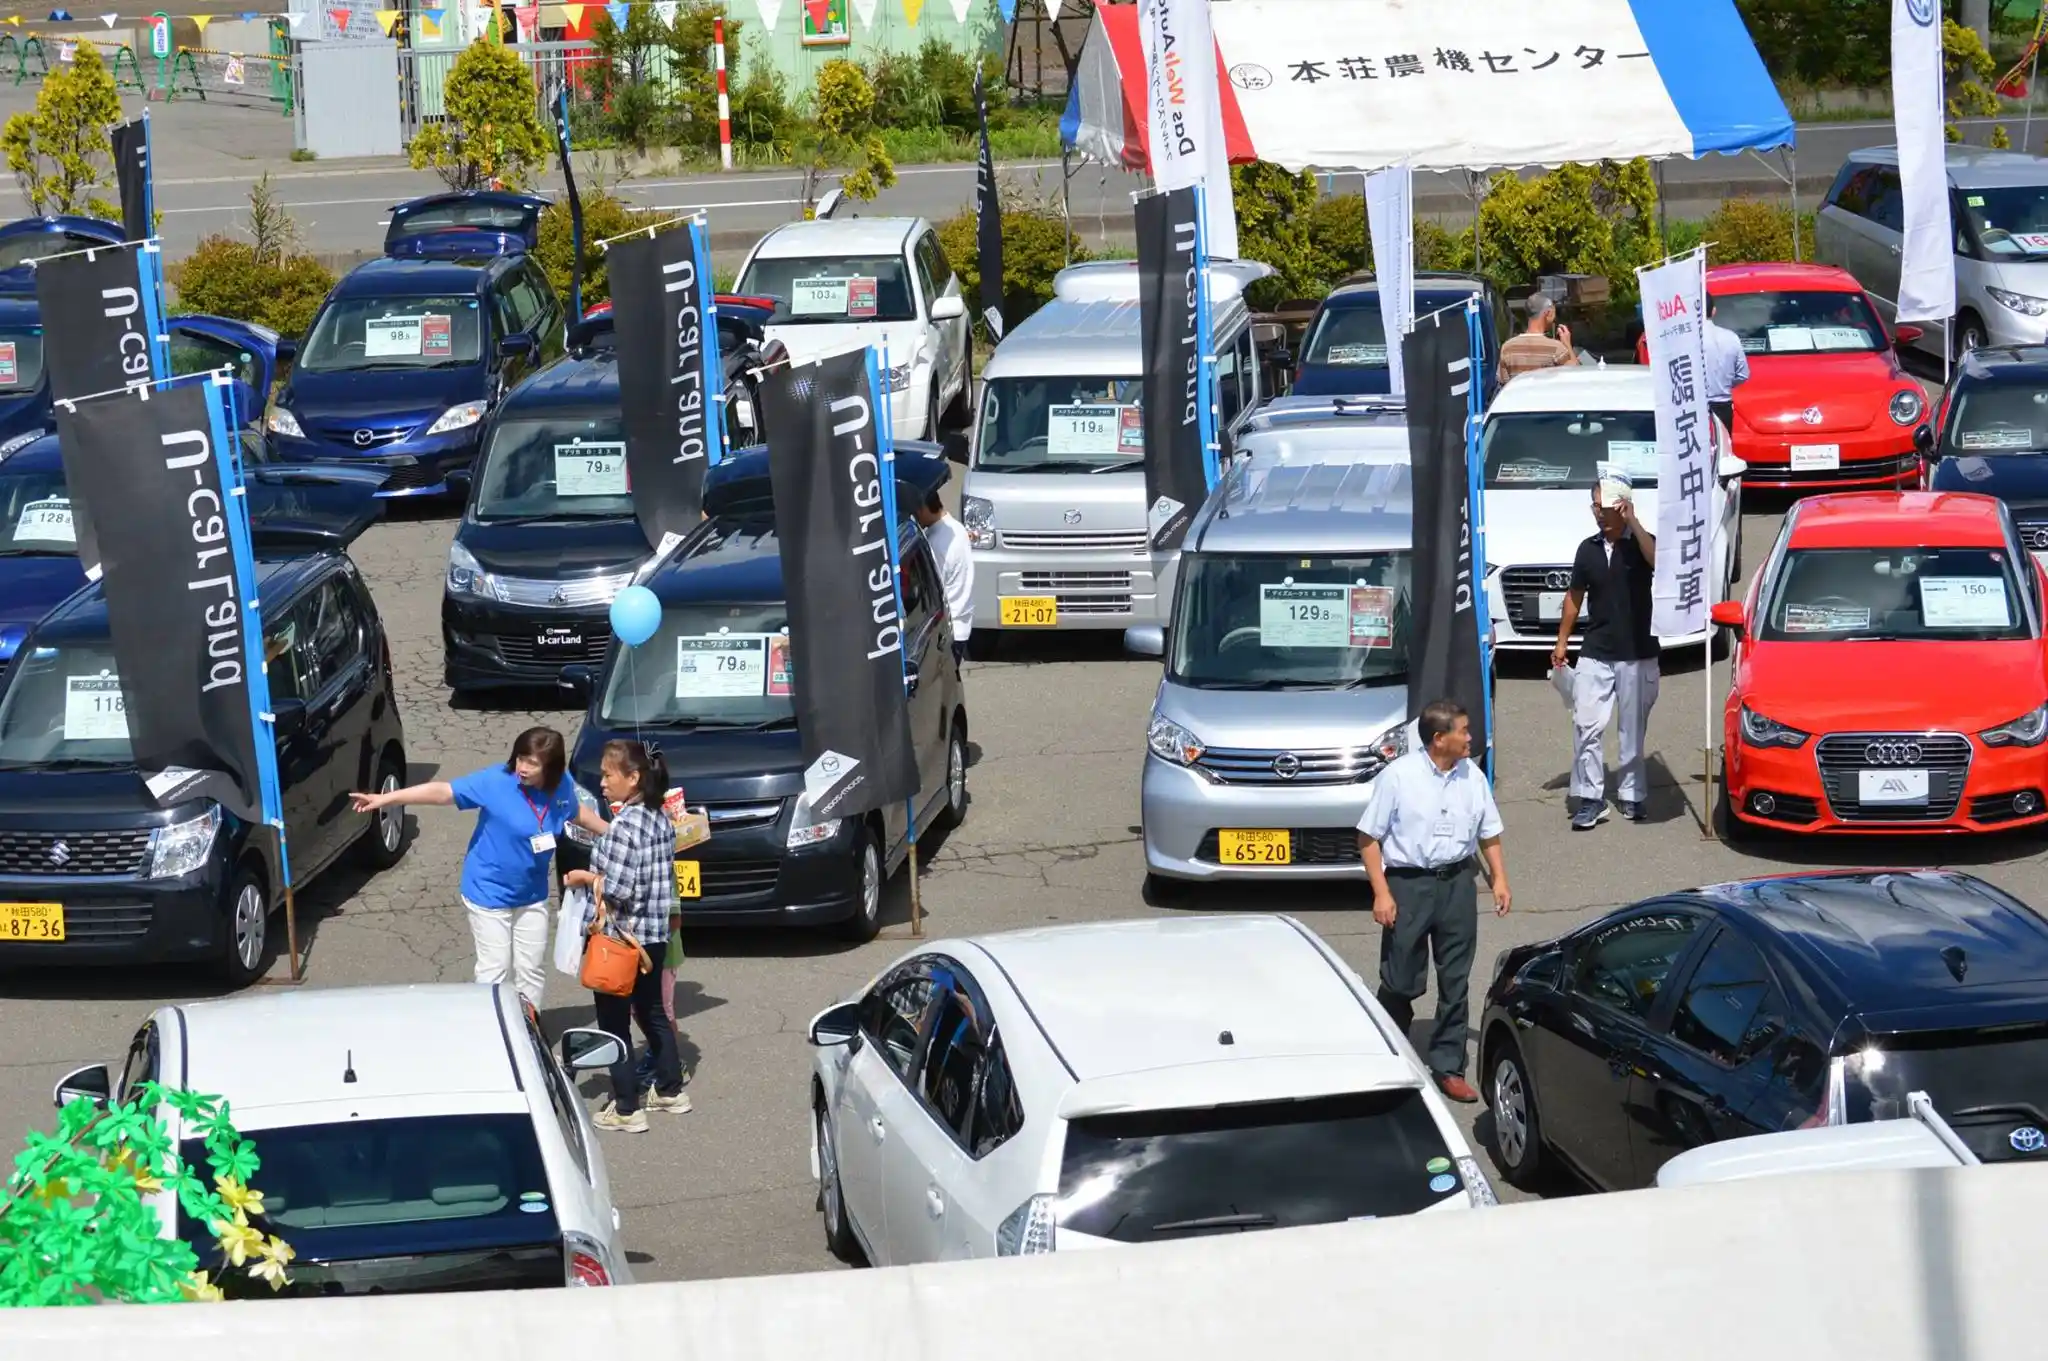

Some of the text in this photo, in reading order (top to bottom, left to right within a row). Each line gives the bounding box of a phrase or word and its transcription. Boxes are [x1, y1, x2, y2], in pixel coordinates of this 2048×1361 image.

[1287, 45, 1650, 84] 本荘農機センター
[1071, 420, 1104, 433] 119.8
[586, 460, 611, 473] 79.8
[1013, 608, 1053, 623] 21-07
[1289, 605, 1329, 620] 129.8
[1236, 844, 1286, 861] 65-20
[11, 919, 60, 936] 87-36
